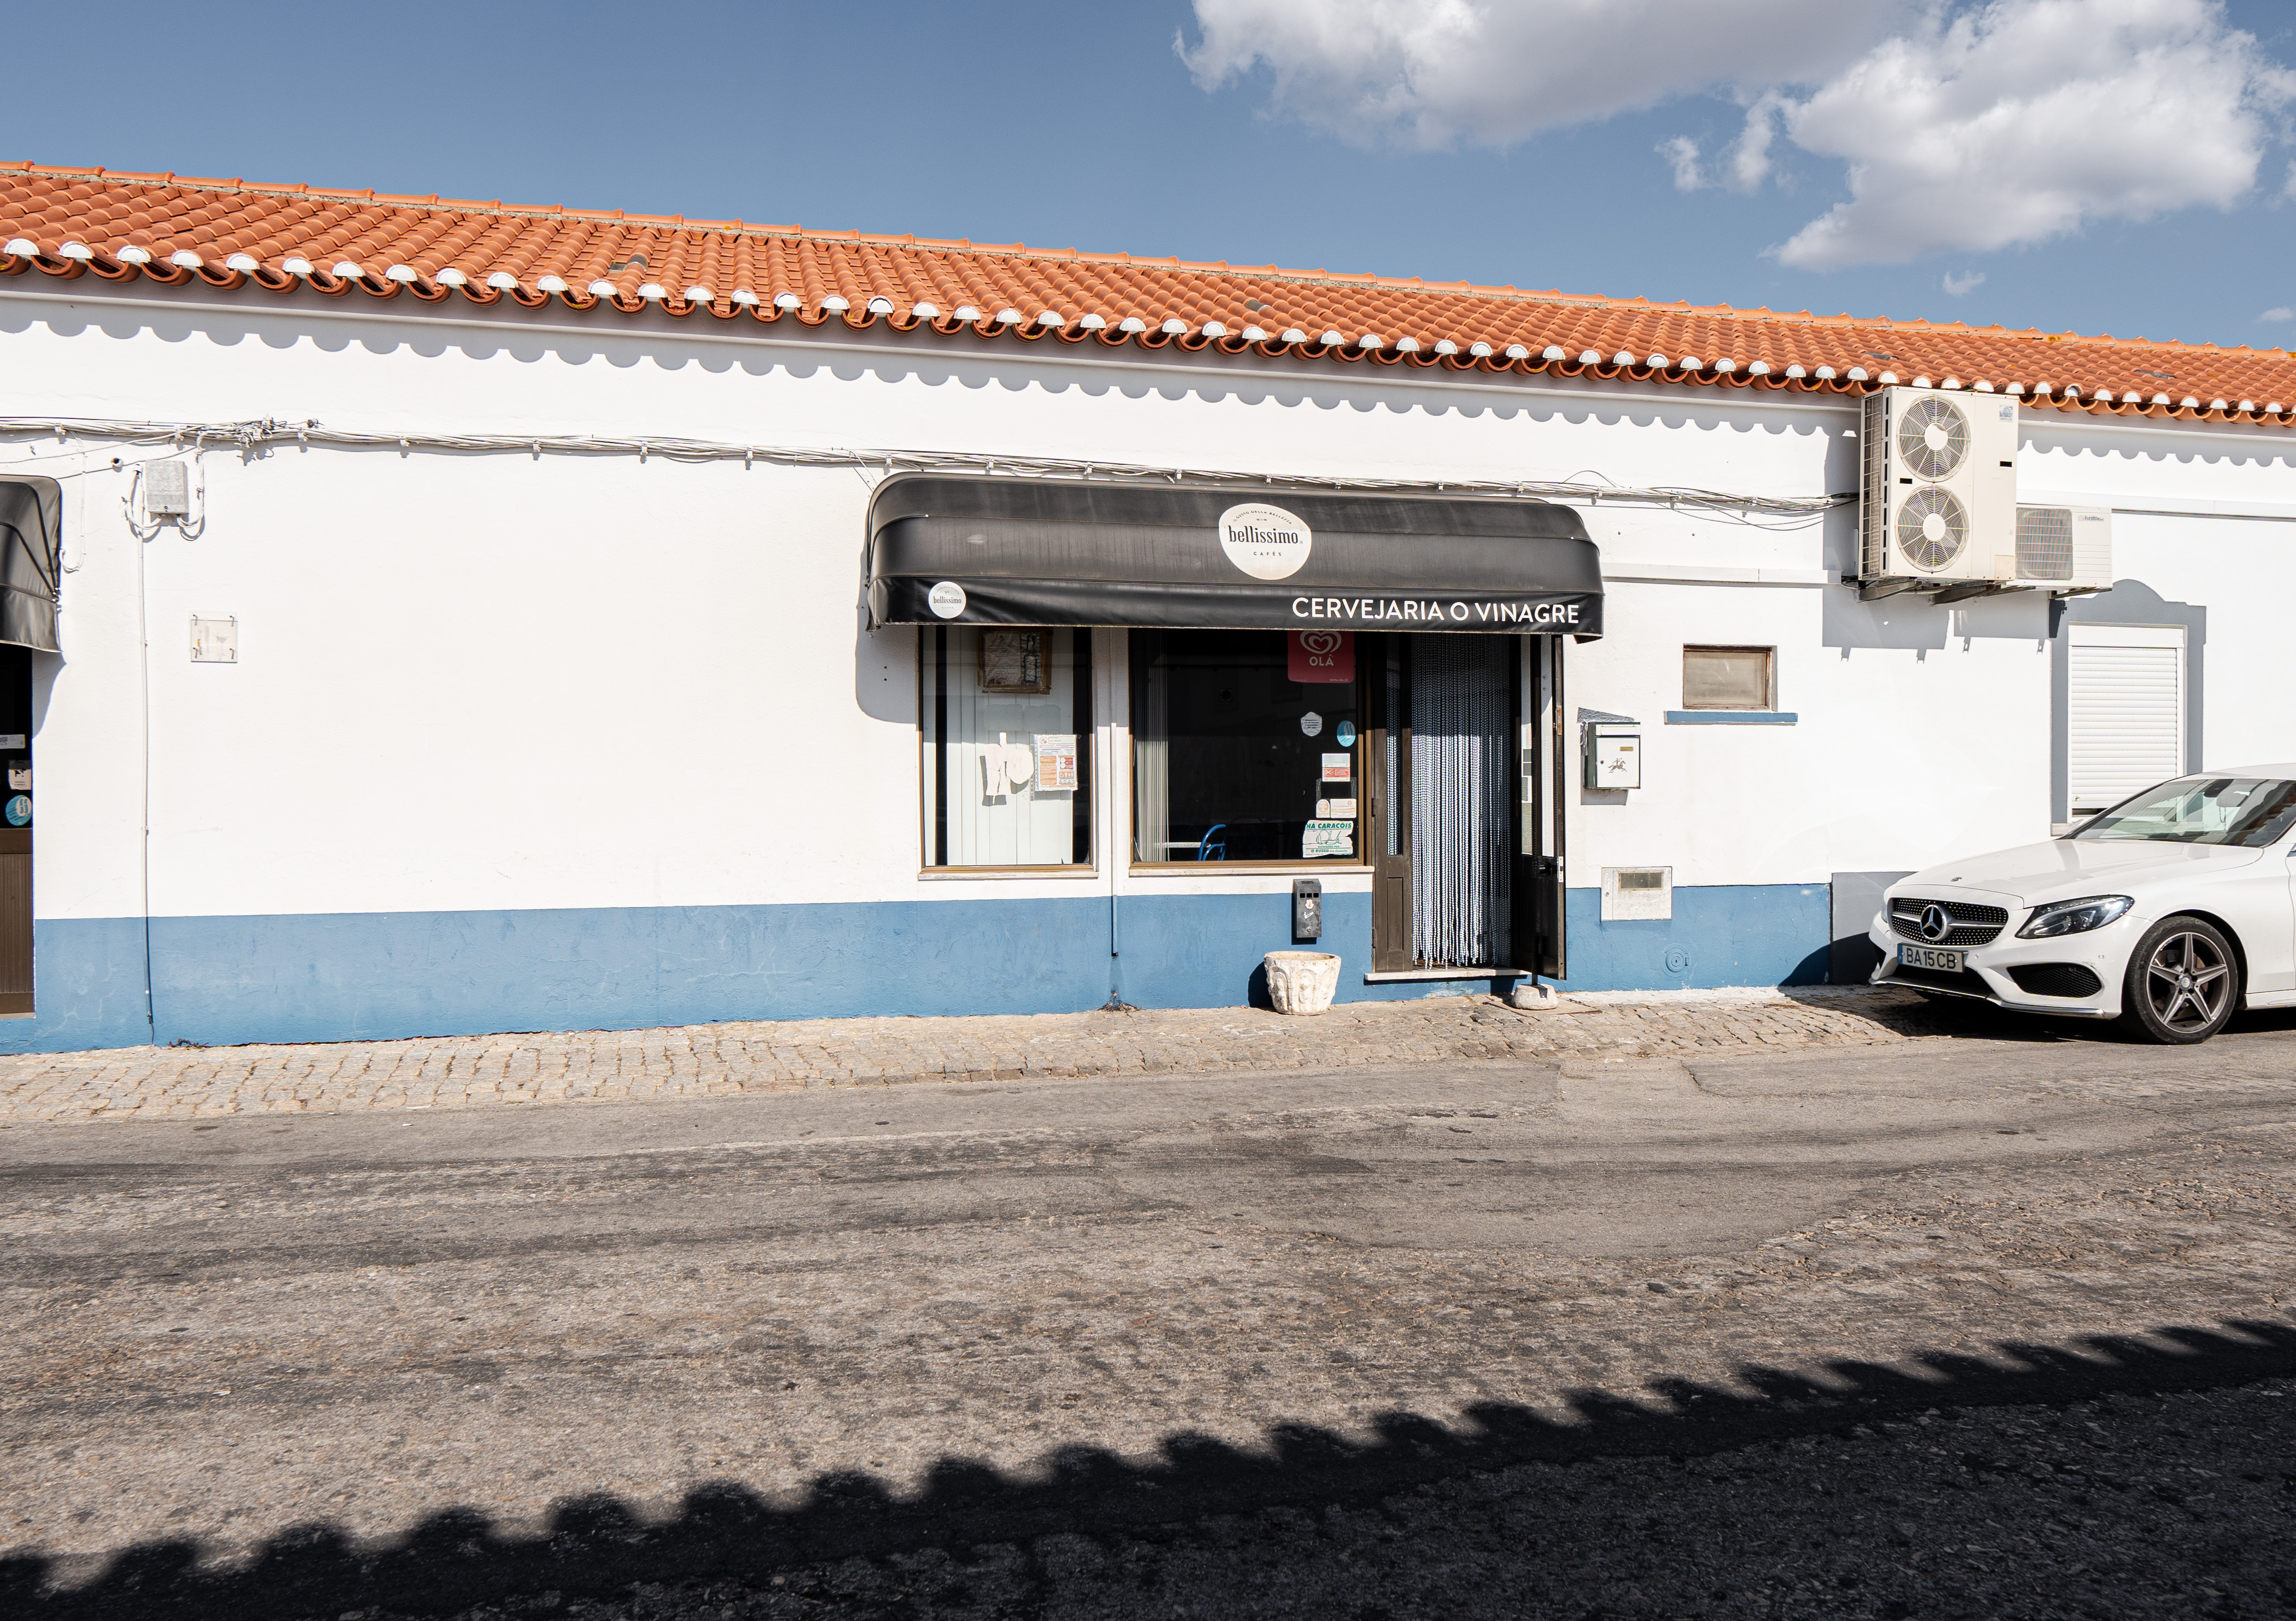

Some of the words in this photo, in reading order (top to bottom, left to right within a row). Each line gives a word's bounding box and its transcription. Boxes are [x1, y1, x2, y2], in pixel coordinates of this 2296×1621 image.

[1269, 512, 1292, 525] BELLEZZA
[1227, 525, 1298, 544] bellissimo
[1292, 597, 1444, 621] CERVEJARIA
[1450, 602, 1469, 621] O
[1475, 602, 1580, 624] VINAGRE
[1309, 654, 1334, 666] OLÁ
